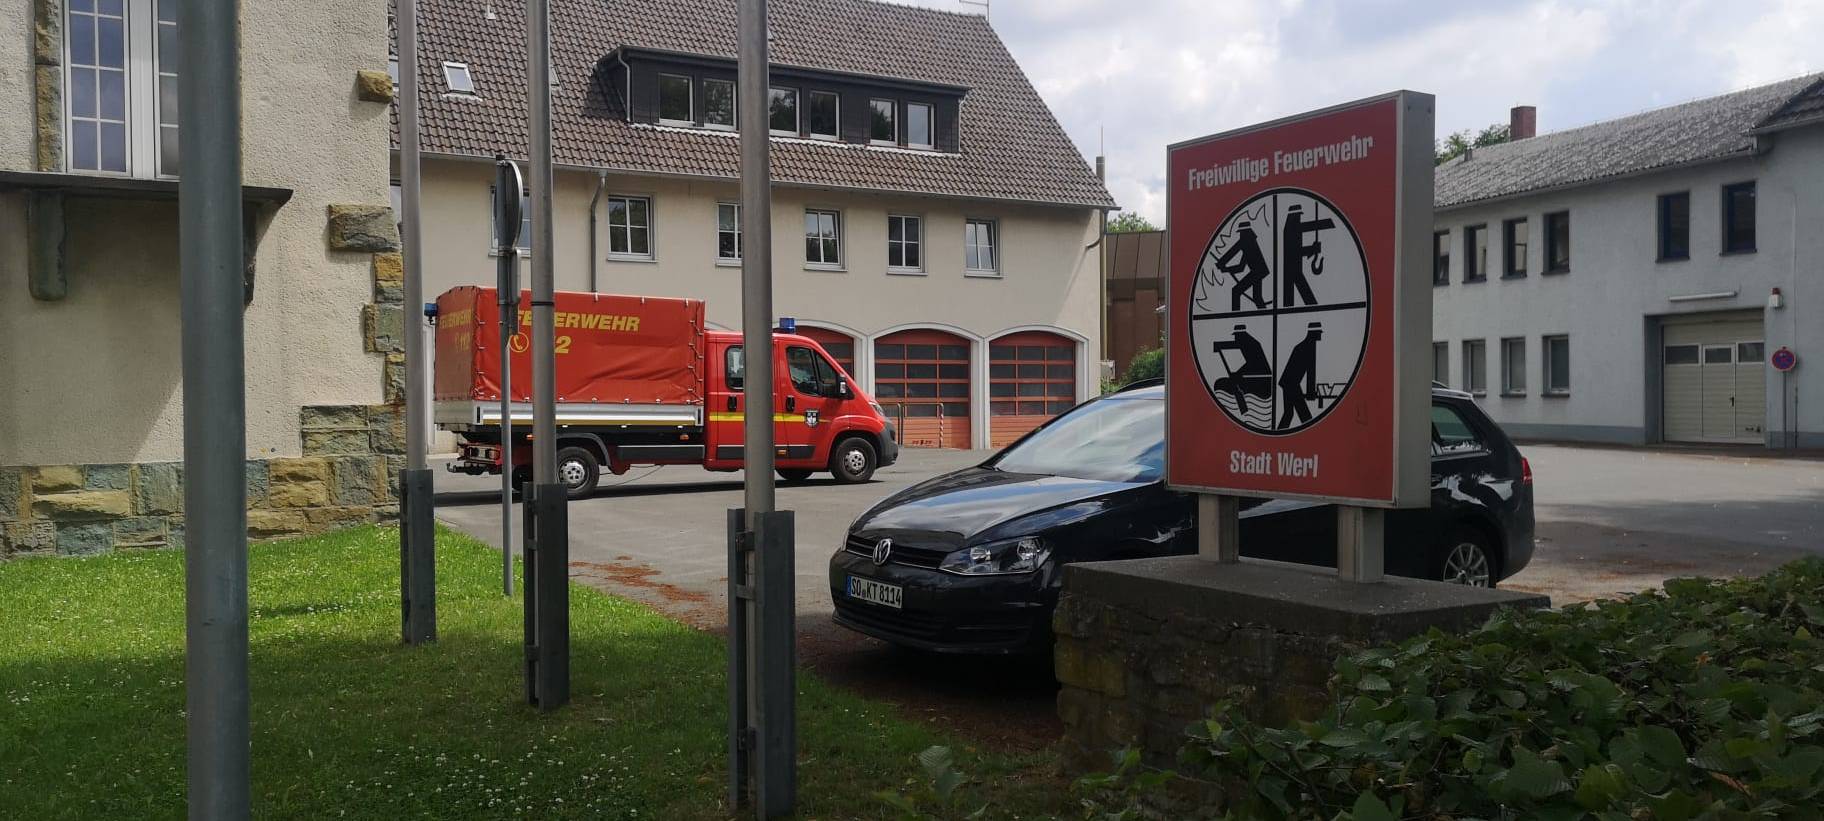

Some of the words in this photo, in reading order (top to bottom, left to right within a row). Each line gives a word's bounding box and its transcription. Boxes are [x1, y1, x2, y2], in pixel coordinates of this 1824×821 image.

[1188, 157, 1269, 190] Freiwillige
[1274, 135, 1373, 175] Feuerwehr
[1230, 450, 1272, 475] Stadt
[1277, 452, 1318, 478] Werl
[852, 578, 861, 596] SO
[866, 581, 877, 600] KT
[880, 585, 901, 606] 8114
